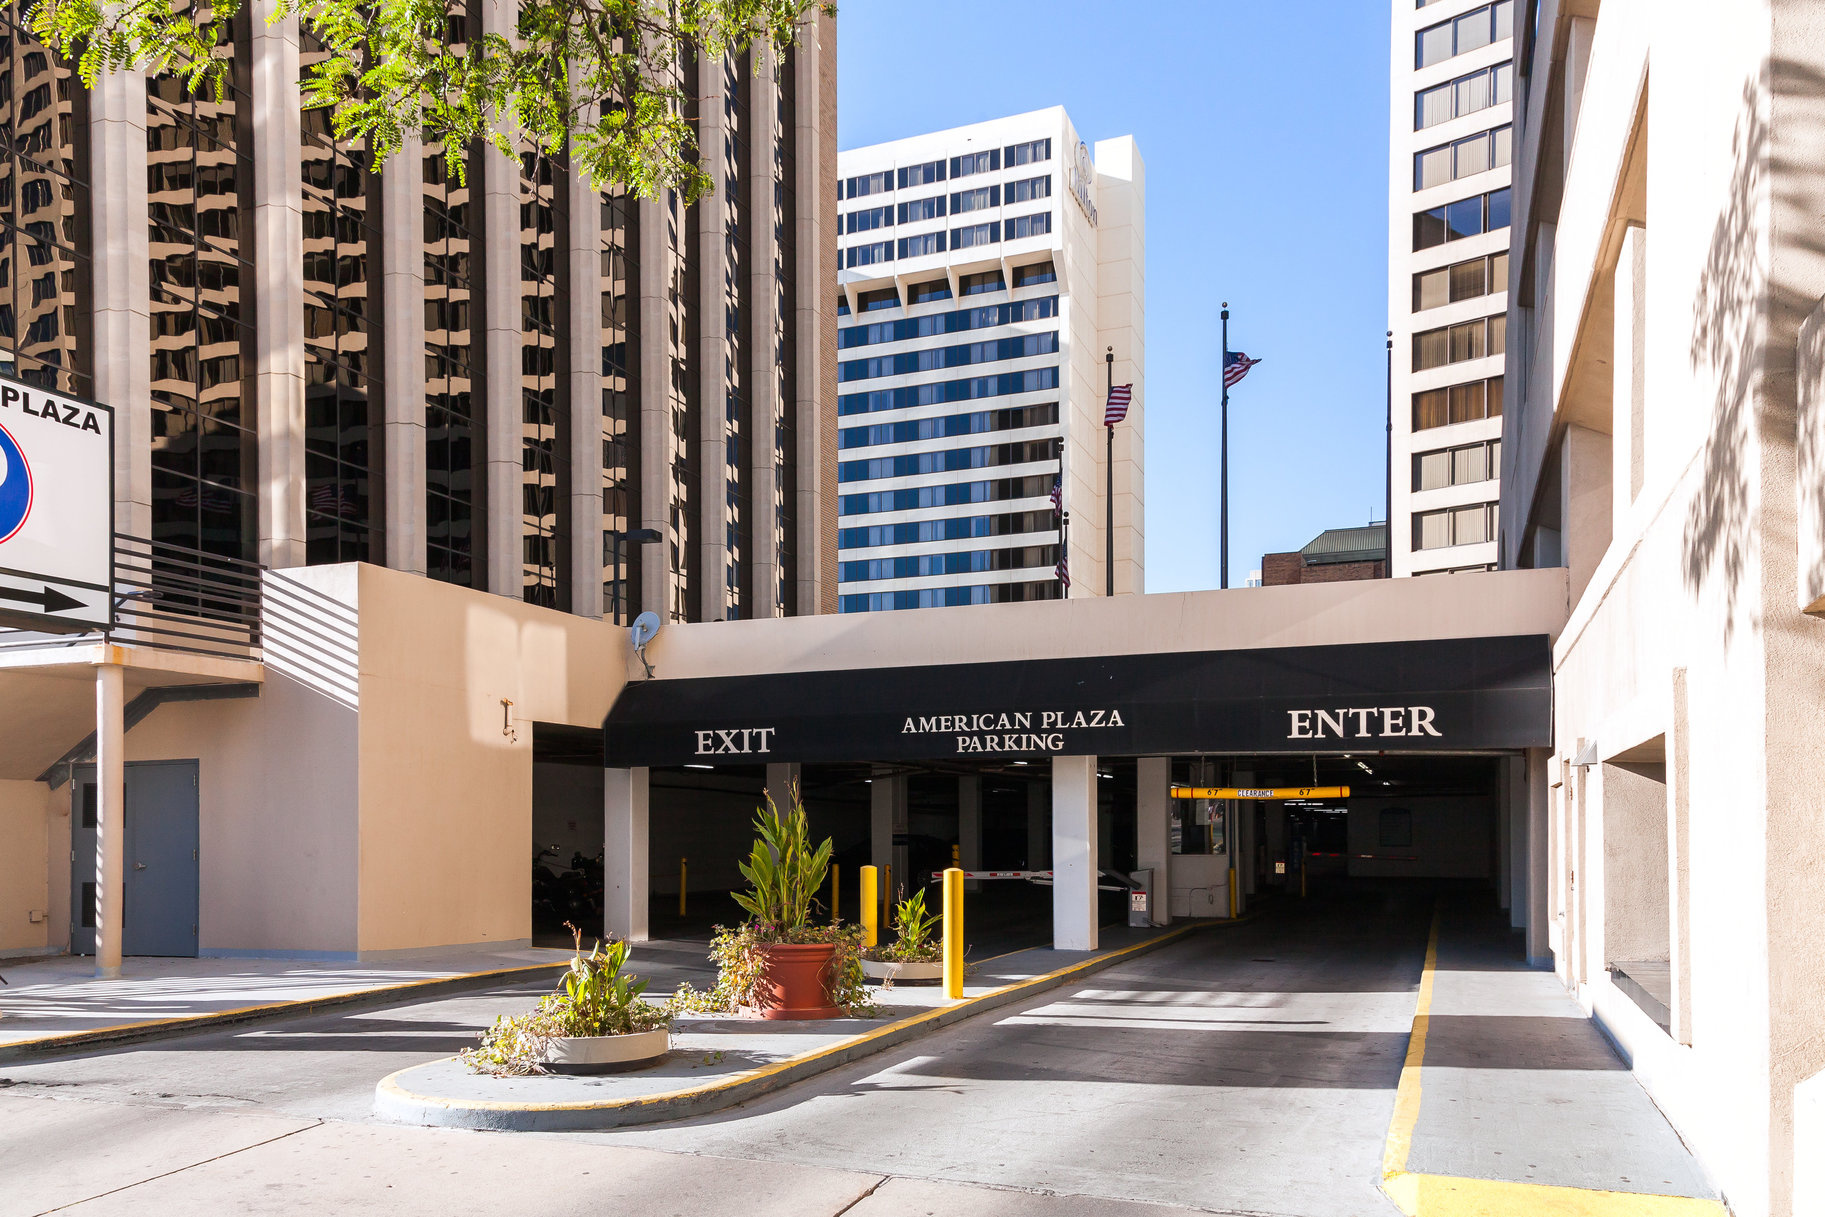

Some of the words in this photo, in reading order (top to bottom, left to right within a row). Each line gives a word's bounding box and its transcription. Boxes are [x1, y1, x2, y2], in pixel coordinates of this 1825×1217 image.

[1, 385, 102, 435] PLAZA
[901, 712, 1032, 734] AMERICAN
[1041, 709, 1125, 728] PLAZA
[1286, 706, 1443, 739] ENTER
[694, 727, 776, 755] EXIT
[956, 733, 1064, 753] PARKING
[1237, 789, 1274, 798] CLEARANCE
